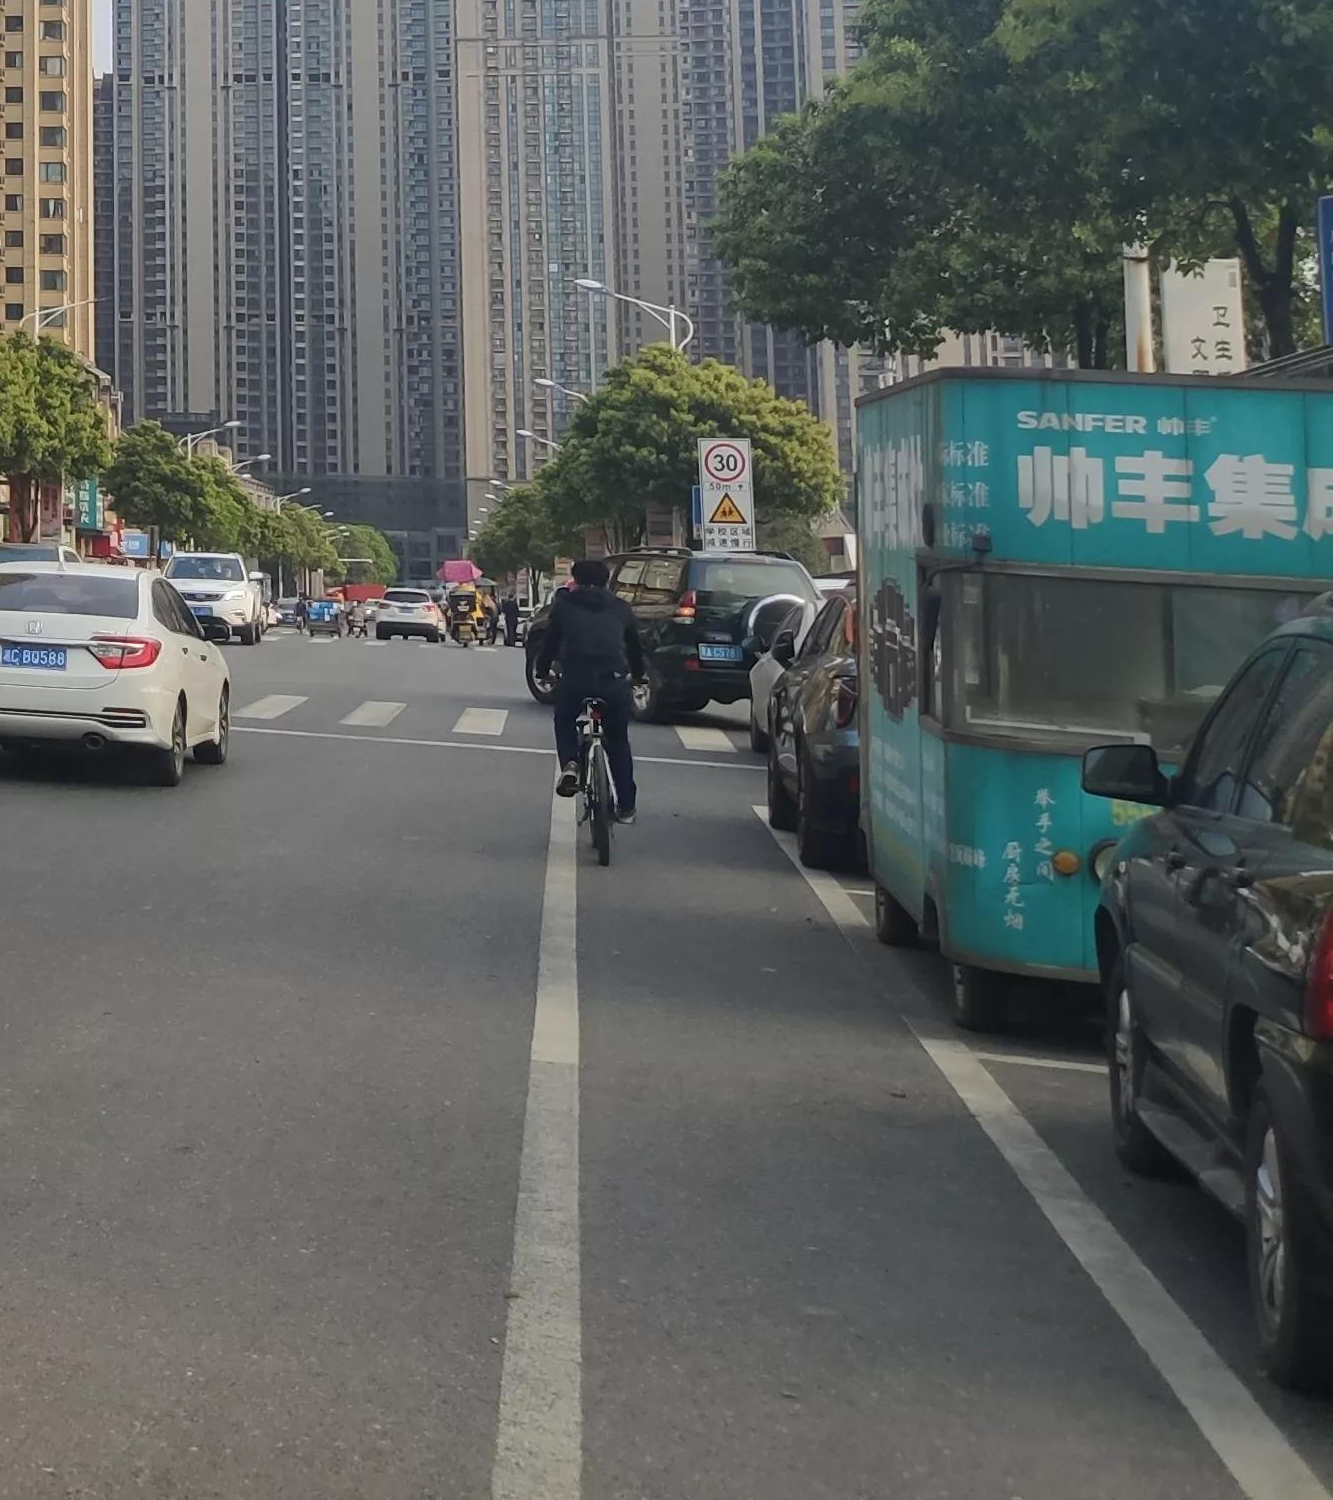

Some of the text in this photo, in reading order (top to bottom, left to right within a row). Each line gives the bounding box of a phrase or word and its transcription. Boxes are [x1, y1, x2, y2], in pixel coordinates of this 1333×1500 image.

[1017, 410, 1148, 435] SANFER
[713, 453, 738, 472] 30
[709, 482, 731, 491] 50m
[705, 526, 751, 537] 学校区域
[706, 537, 752, 549] 减速慢行
[1034, 787, 1056, 884] 举手之间
[1001, 841, 1026, 932] 厨房无烟
